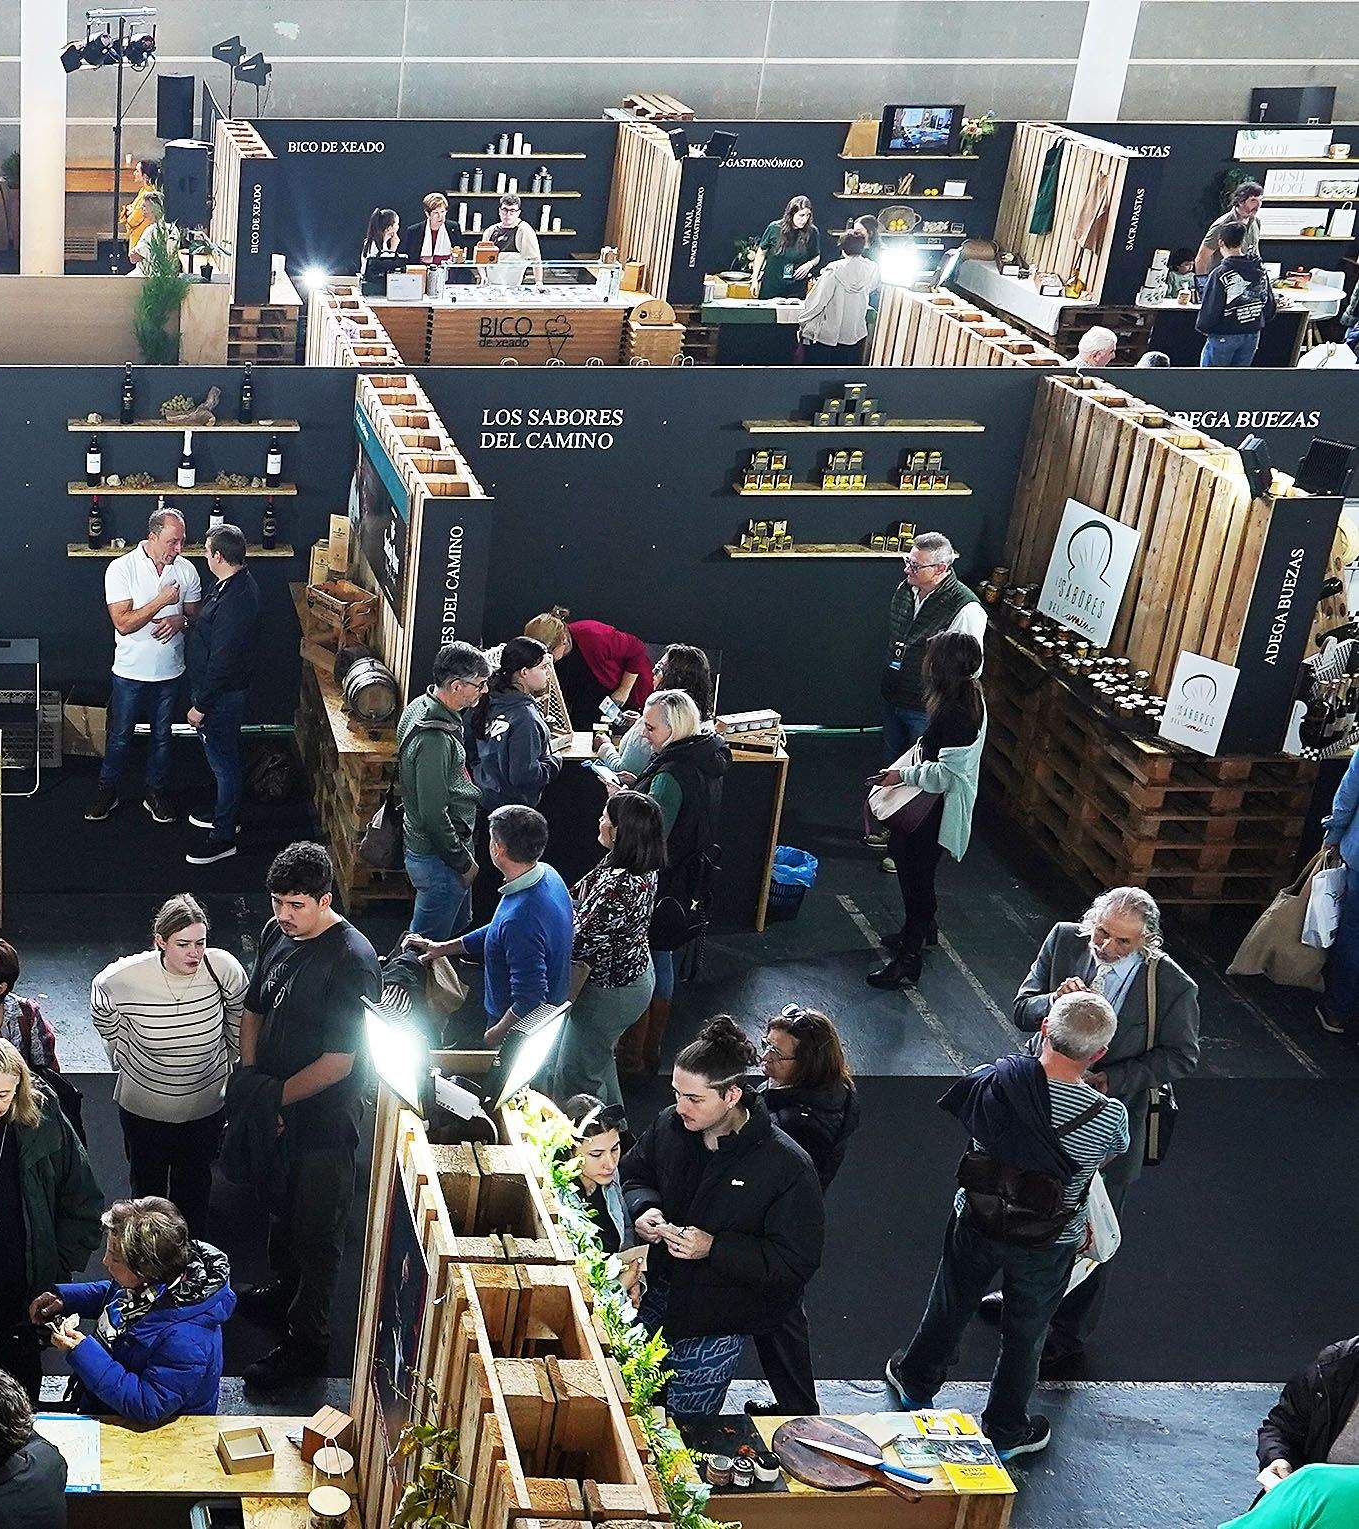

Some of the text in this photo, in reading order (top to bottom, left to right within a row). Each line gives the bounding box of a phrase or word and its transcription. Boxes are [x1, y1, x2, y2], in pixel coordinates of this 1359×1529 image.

[288, 141, 385, 153] BICO DE XEADO
[726, 157, 804, 169] GASTRONÓMICO
[251, 184, 262, 254] BICO DE XEADO
[1125, 188, 1146, 251] SACRAPASTAS
[480, 316, 532, 335] BICO
[479, 337, 530, 348] de xeado
[481, 408, 624, 427] LOS SABORES
[1170, 411, 1321, 428] DEGA BUEZAS
[479, 431, 614, 450] DEL CAMINO
[445, 525, 464, 590] CAMINO
[442, 592, 458, 623] DEL
[1264, 548, 1305, 666] ADEGA BUEZAS
